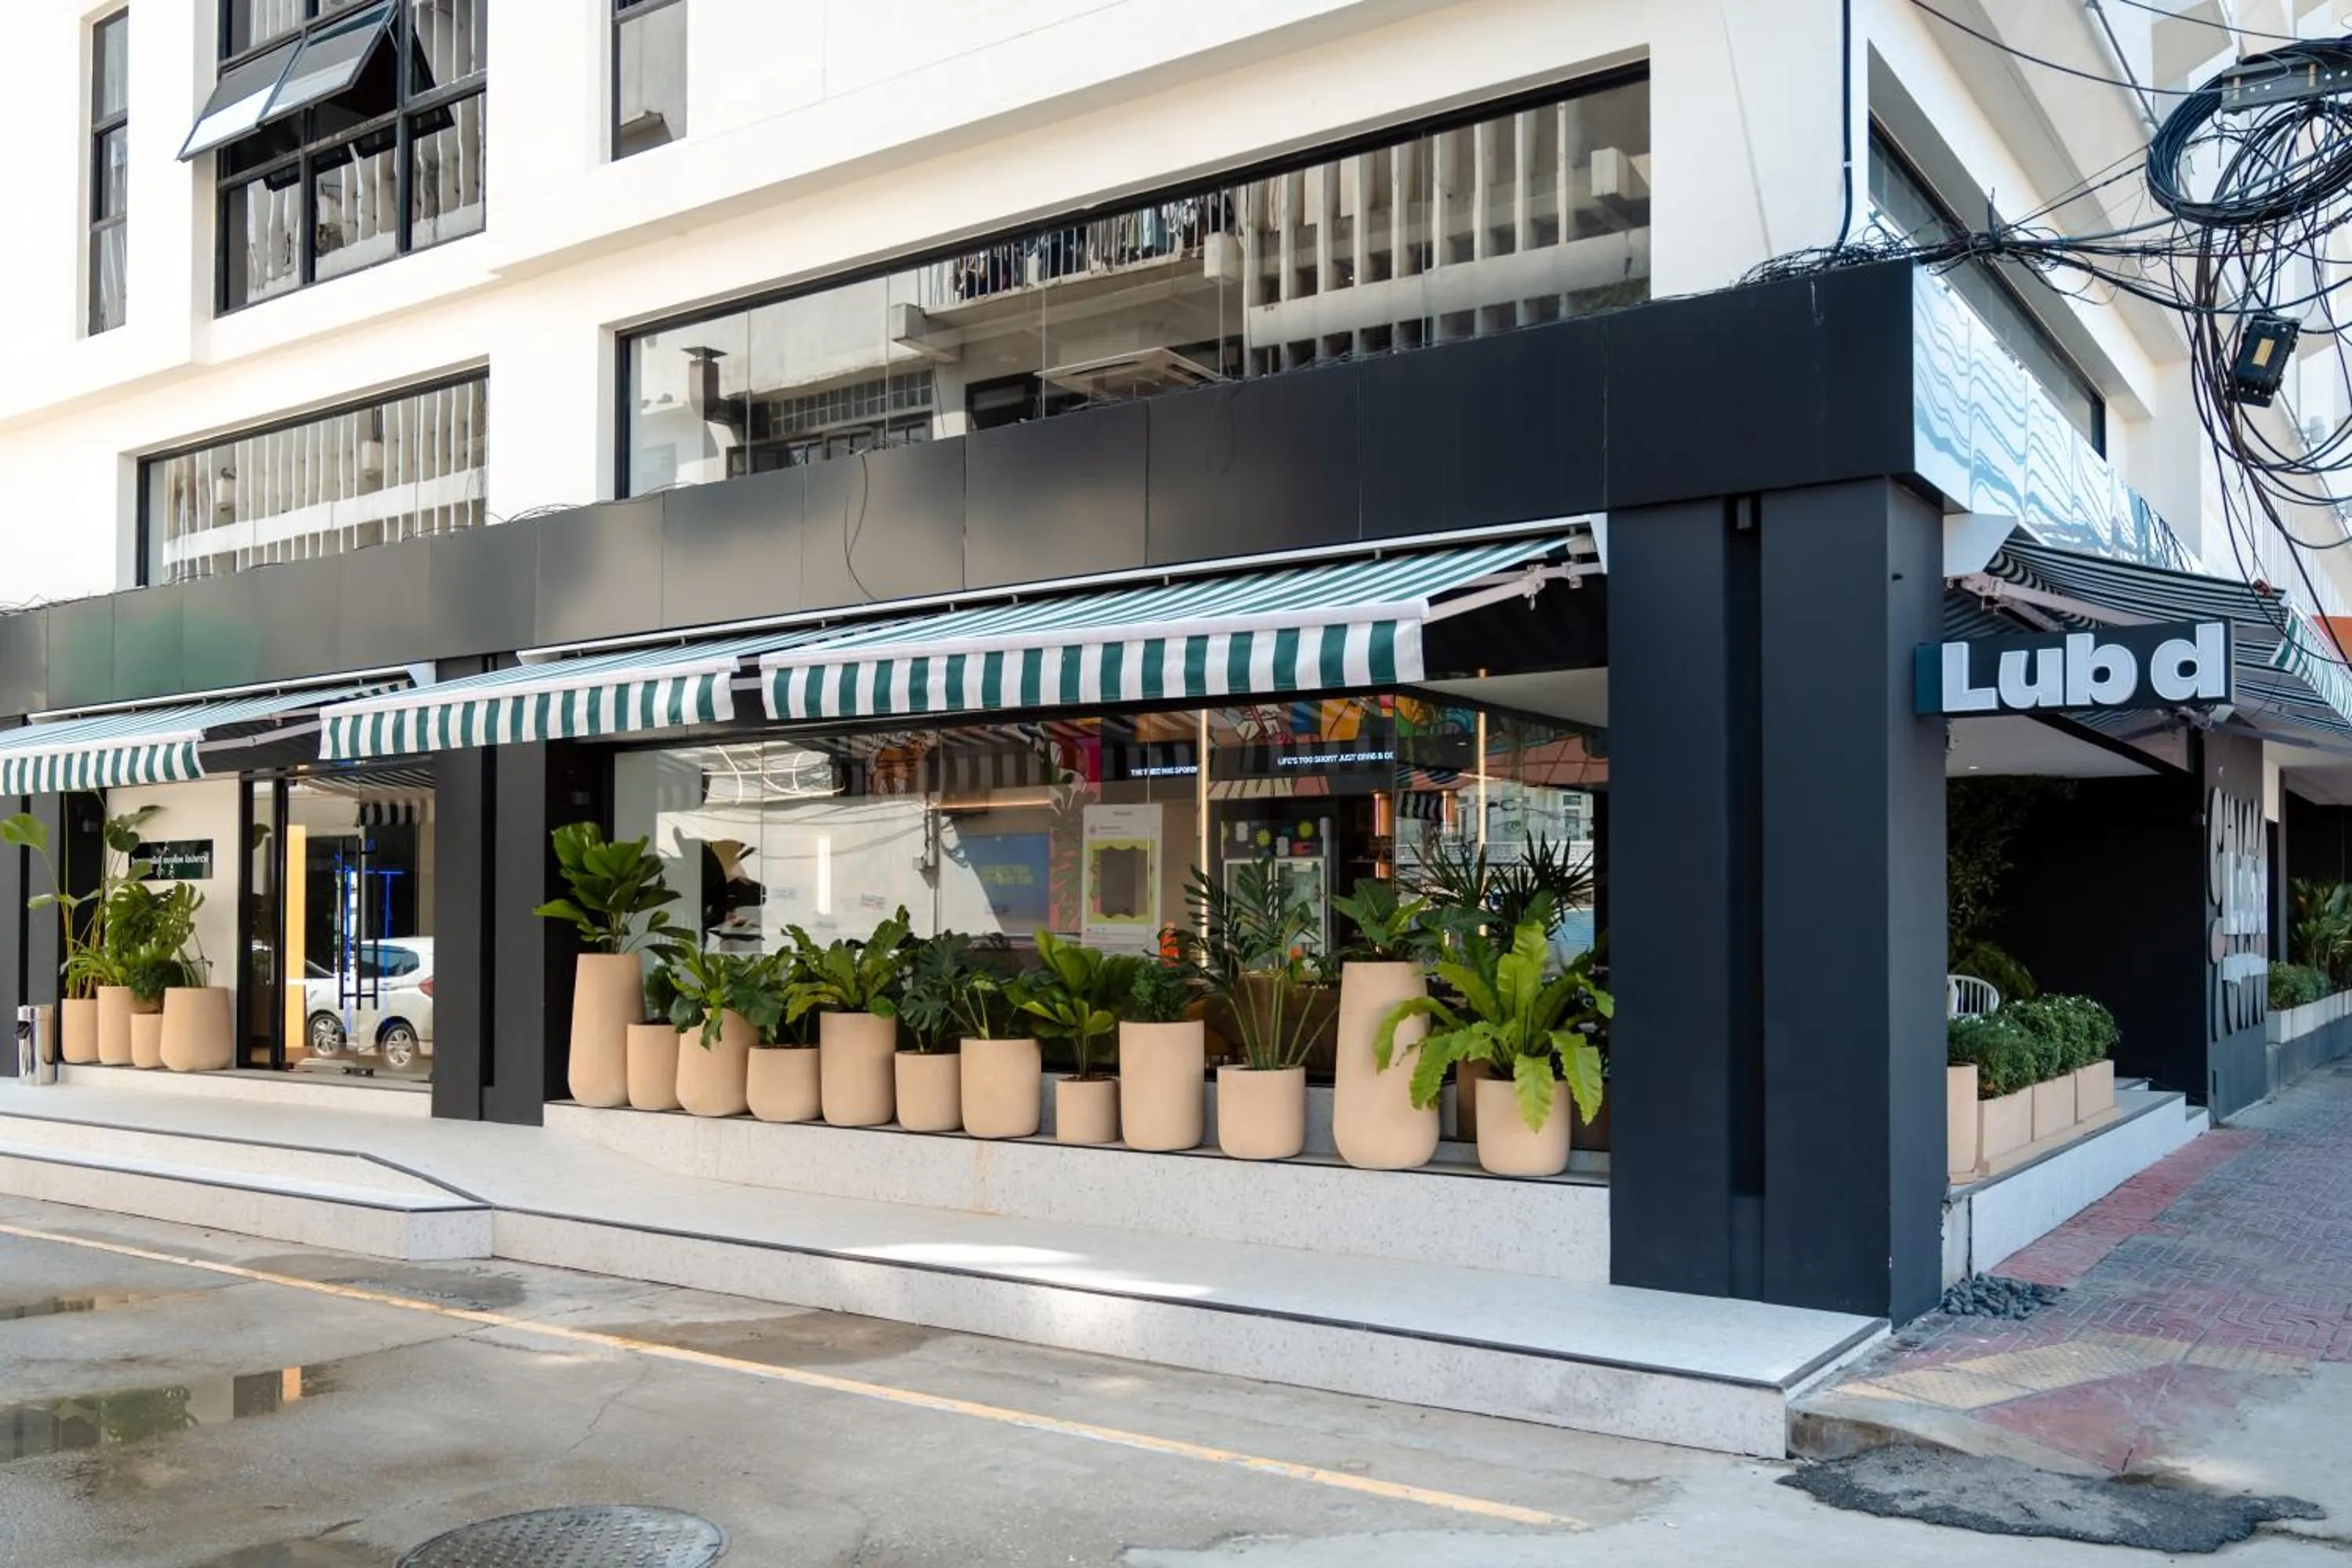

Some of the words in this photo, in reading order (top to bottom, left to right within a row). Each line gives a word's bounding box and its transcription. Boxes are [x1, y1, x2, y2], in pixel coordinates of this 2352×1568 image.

[1942, 633, 2138, 713] Lub
[2151, 622, 2226, 701] d
[1314, 754, 1338, 763] SHORT
